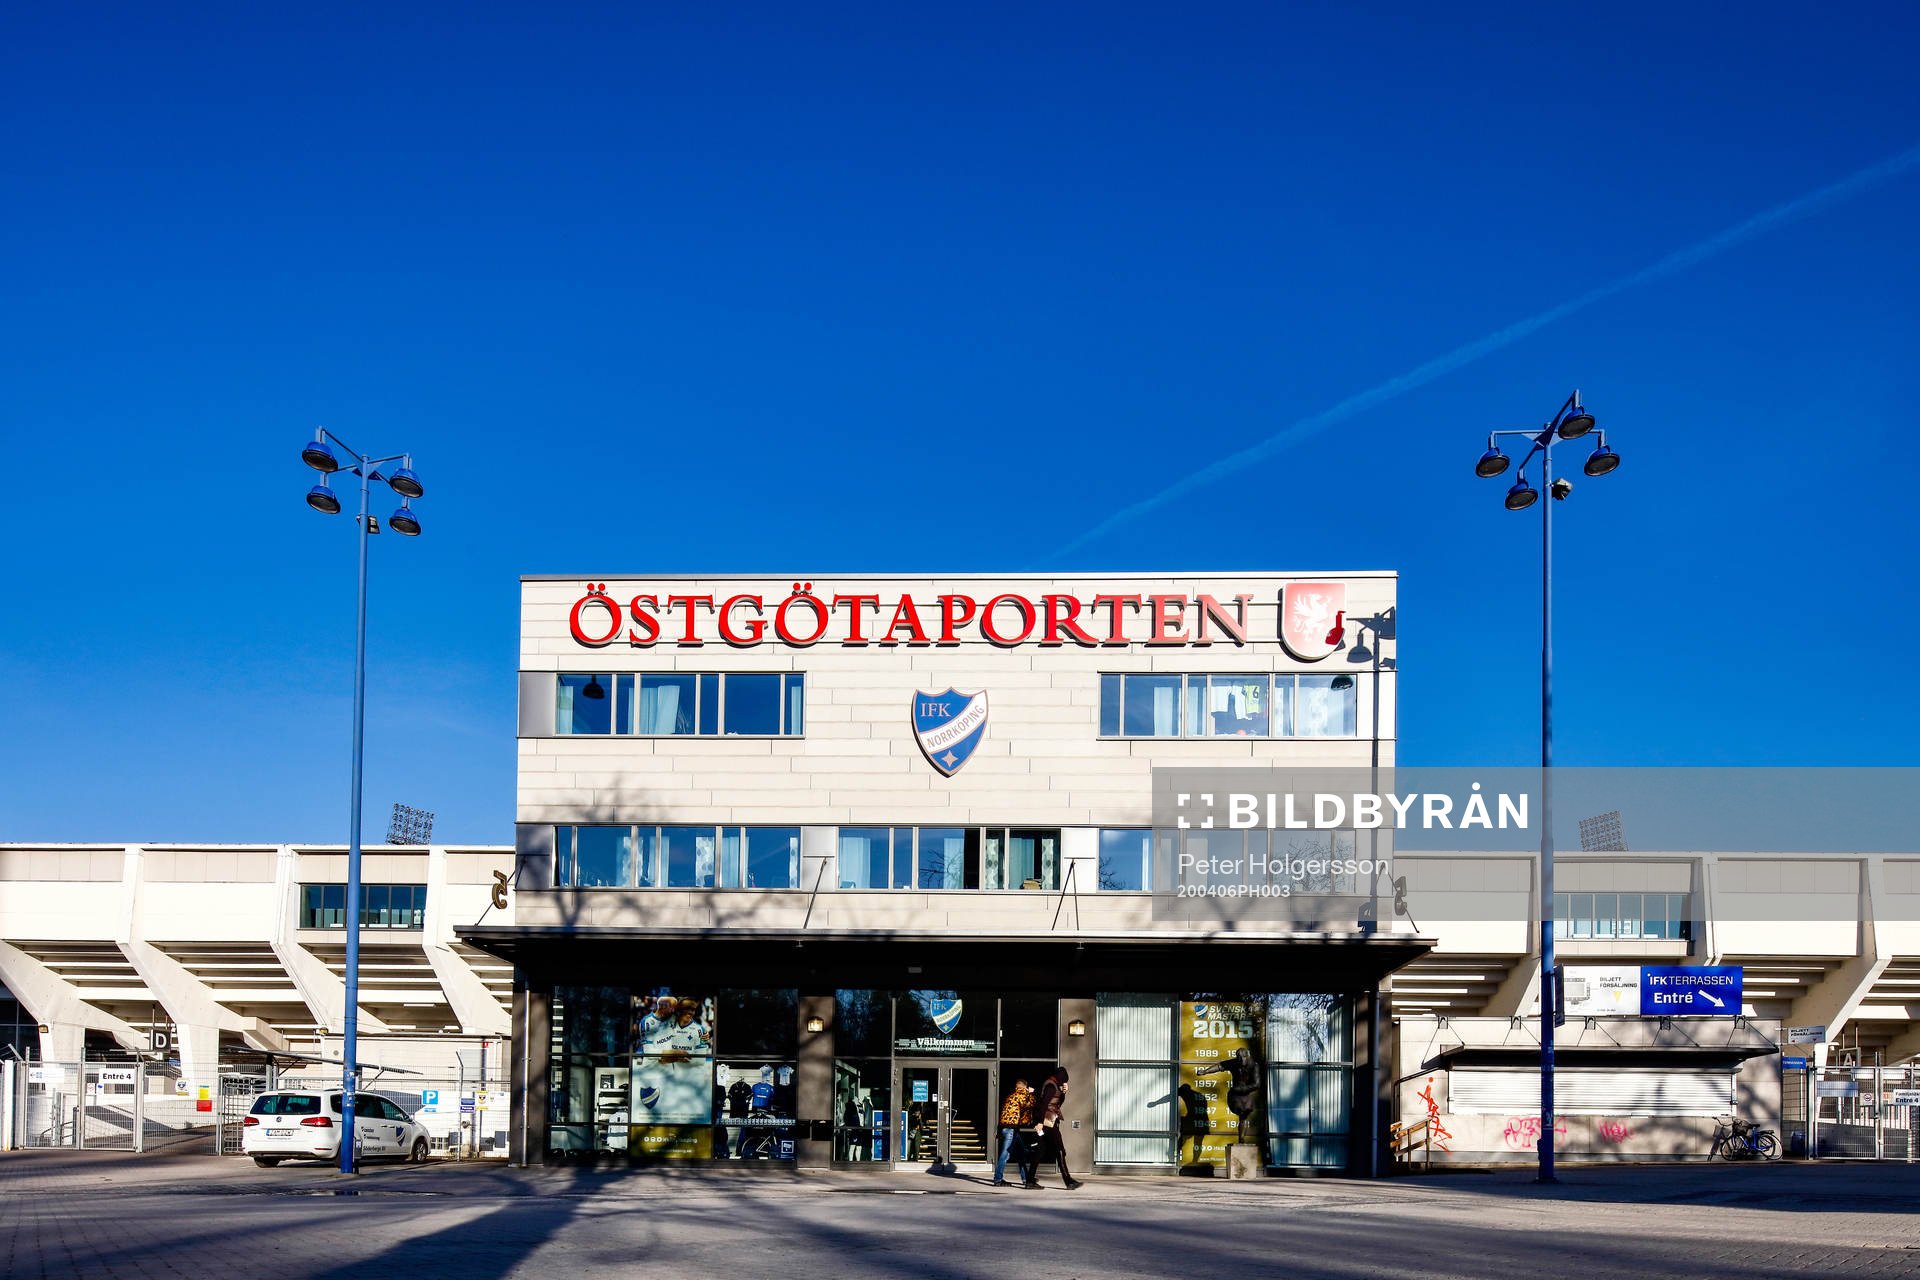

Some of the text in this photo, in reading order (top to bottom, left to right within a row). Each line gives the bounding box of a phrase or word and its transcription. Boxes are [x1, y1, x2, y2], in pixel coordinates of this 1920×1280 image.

[569, 582, 1254, 647] ÖSTGÖTAPORTEN
[1252, 686, 1259, 699] 6
[920, 702, 952, 717] IFK
[926, 705, 985, 748] NORRKÖPING
[1653, 991, 1693, 1004] Entré
[1193, 1020, 1253, 1039] 2015
[155, 1033, 167, 1048] D
[916, 1037, 975, 1046] Välkommen
[1195, 1049, 1218, 1058] 1989
[1843, 1052, 1853, 1066] A
[102, 1072, 124, 1080] Entré
[1194, 1080, 1217, 1088] 1957
[426, 1091, 437, 1104] P
